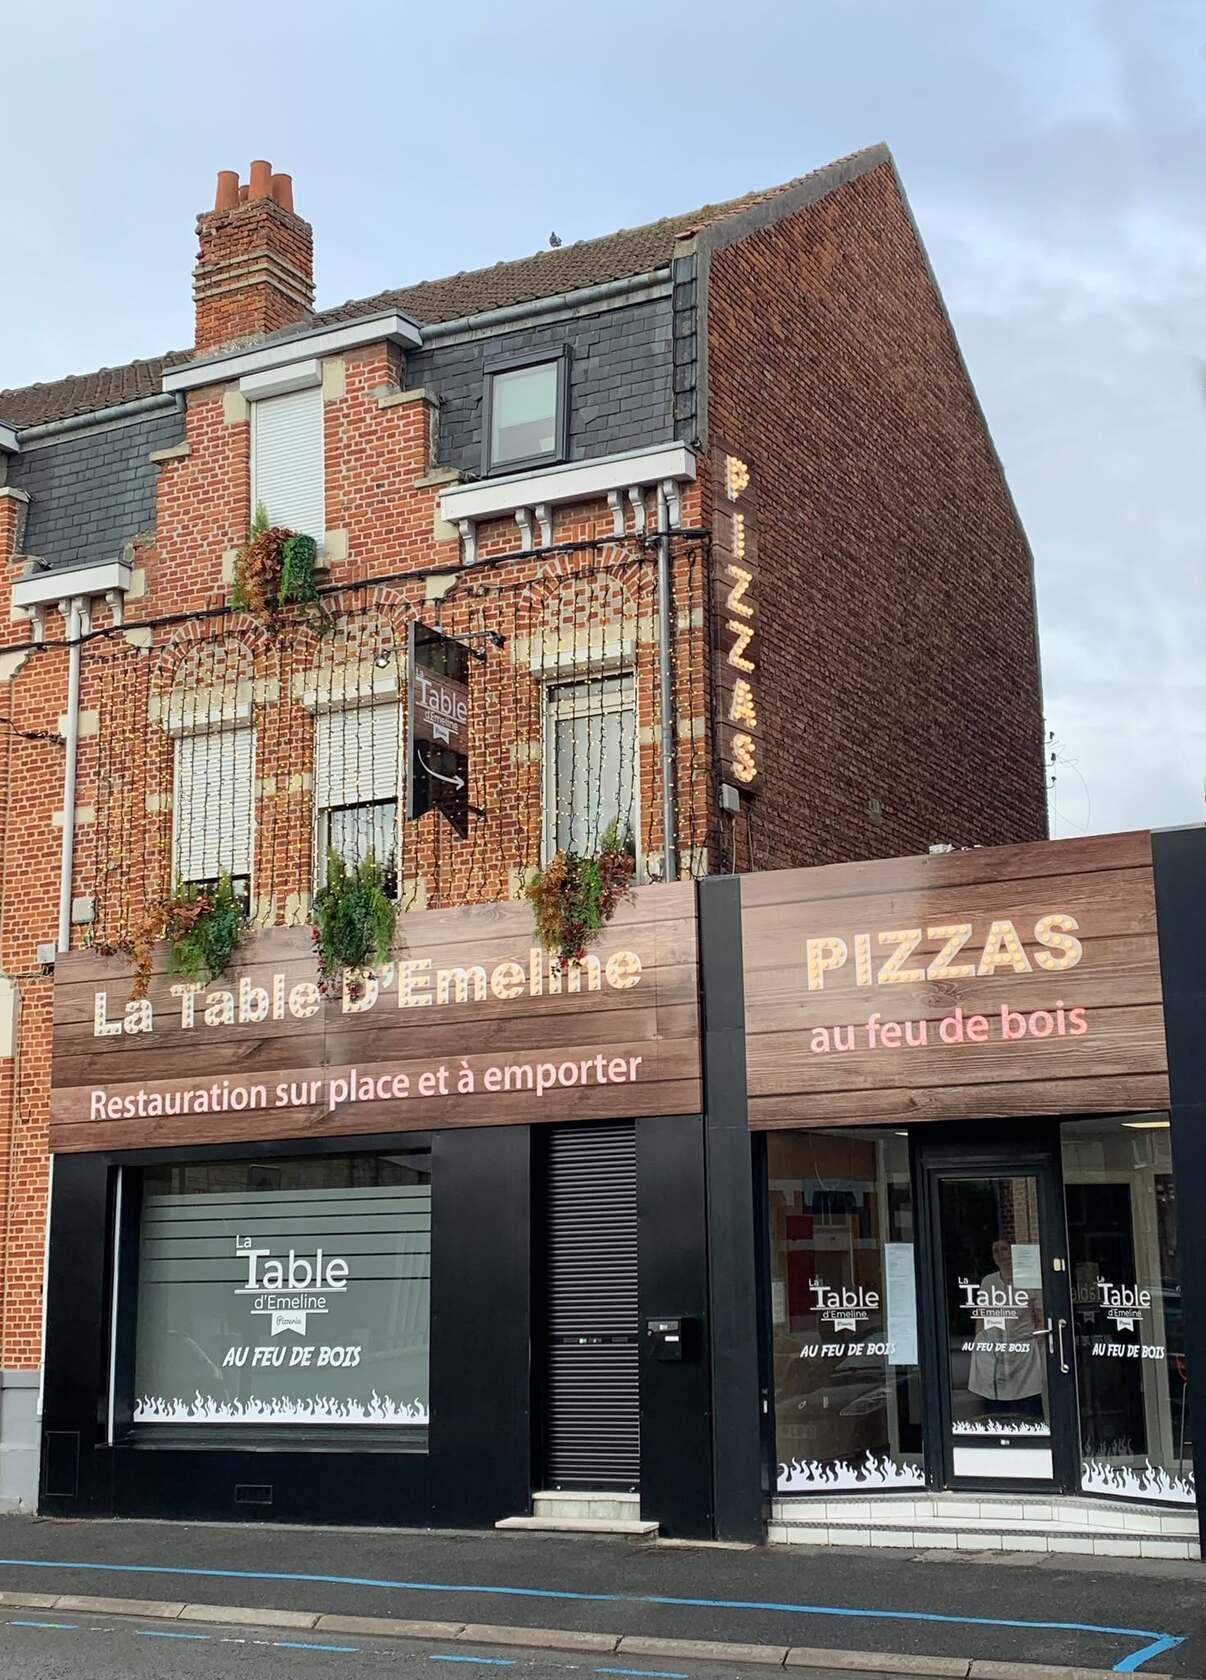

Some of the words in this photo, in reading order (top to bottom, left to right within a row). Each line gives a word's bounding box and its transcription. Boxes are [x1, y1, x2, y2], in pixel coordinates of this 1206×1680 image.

[725, 455, 757, 783] PIZZAS
[415, 676, 467, 721] Table
[806, 914, 1083, 991] PIZZAS
[94, 992, 153, 1037] La
[170, 974, 321, 1029] Table
[342, 948, 642, 1014] D'Emeline
[810, 1025, 855, 1053] au
[865, 1013, 928, 1049] feu
[939, 1007, 989, 1044] de
[1001, 1000, 1088, 1040] bois
[90, 1080, 267, 1121] Restauration
[275, 1080, 321, 1106] sur
[329, 1069, 409, 1111] place
[418, 1065, 449, 1096] et
[457, 1061, 475, 1094] à
[483, 1053, 642, 1096] emporter
[236, 1234, 252, 1249] La
[236, 1248, 349, 1289] Table
[809, 1277, 819, 1287] La
[958, 1276, 969, 1285] La
[254, 1294, 326, 1310] d'Emeline
[809, 1286, 879, 1308] Table
[958, 1284, 1029, 1307] Table
[1097, 1283, 1151, 1306] Table
[822, 1310, 867, 1319] d'Emeline
[222, 1347, 249, 1367] AU
[251, 1347, 287, 1367] FEU
[289, 1347, 315, 1367] DE
[317, 1346, 361, 1367] BOIS
[800, 1344, 819, 1358] AU
[821, 1343, 845, 1357] FEU
[847, 1343, 865, 1356] DE
[866, 1342, 896, 1356] BOIS
[961, 1342, 975, 1352] AU
[976, 1342, 993, 1352] FEU
[995, 1343, 1008, 1352] DE
[1008, 1343, 1030, 1353] BOIS
[1092, 1343, 1106, 1356] AU
[1107, 1344, 1125, 1357] FEU
[1127, 1345, 1140, 1358] DE
[1141, 1345, 1165, 1359] BOIS
